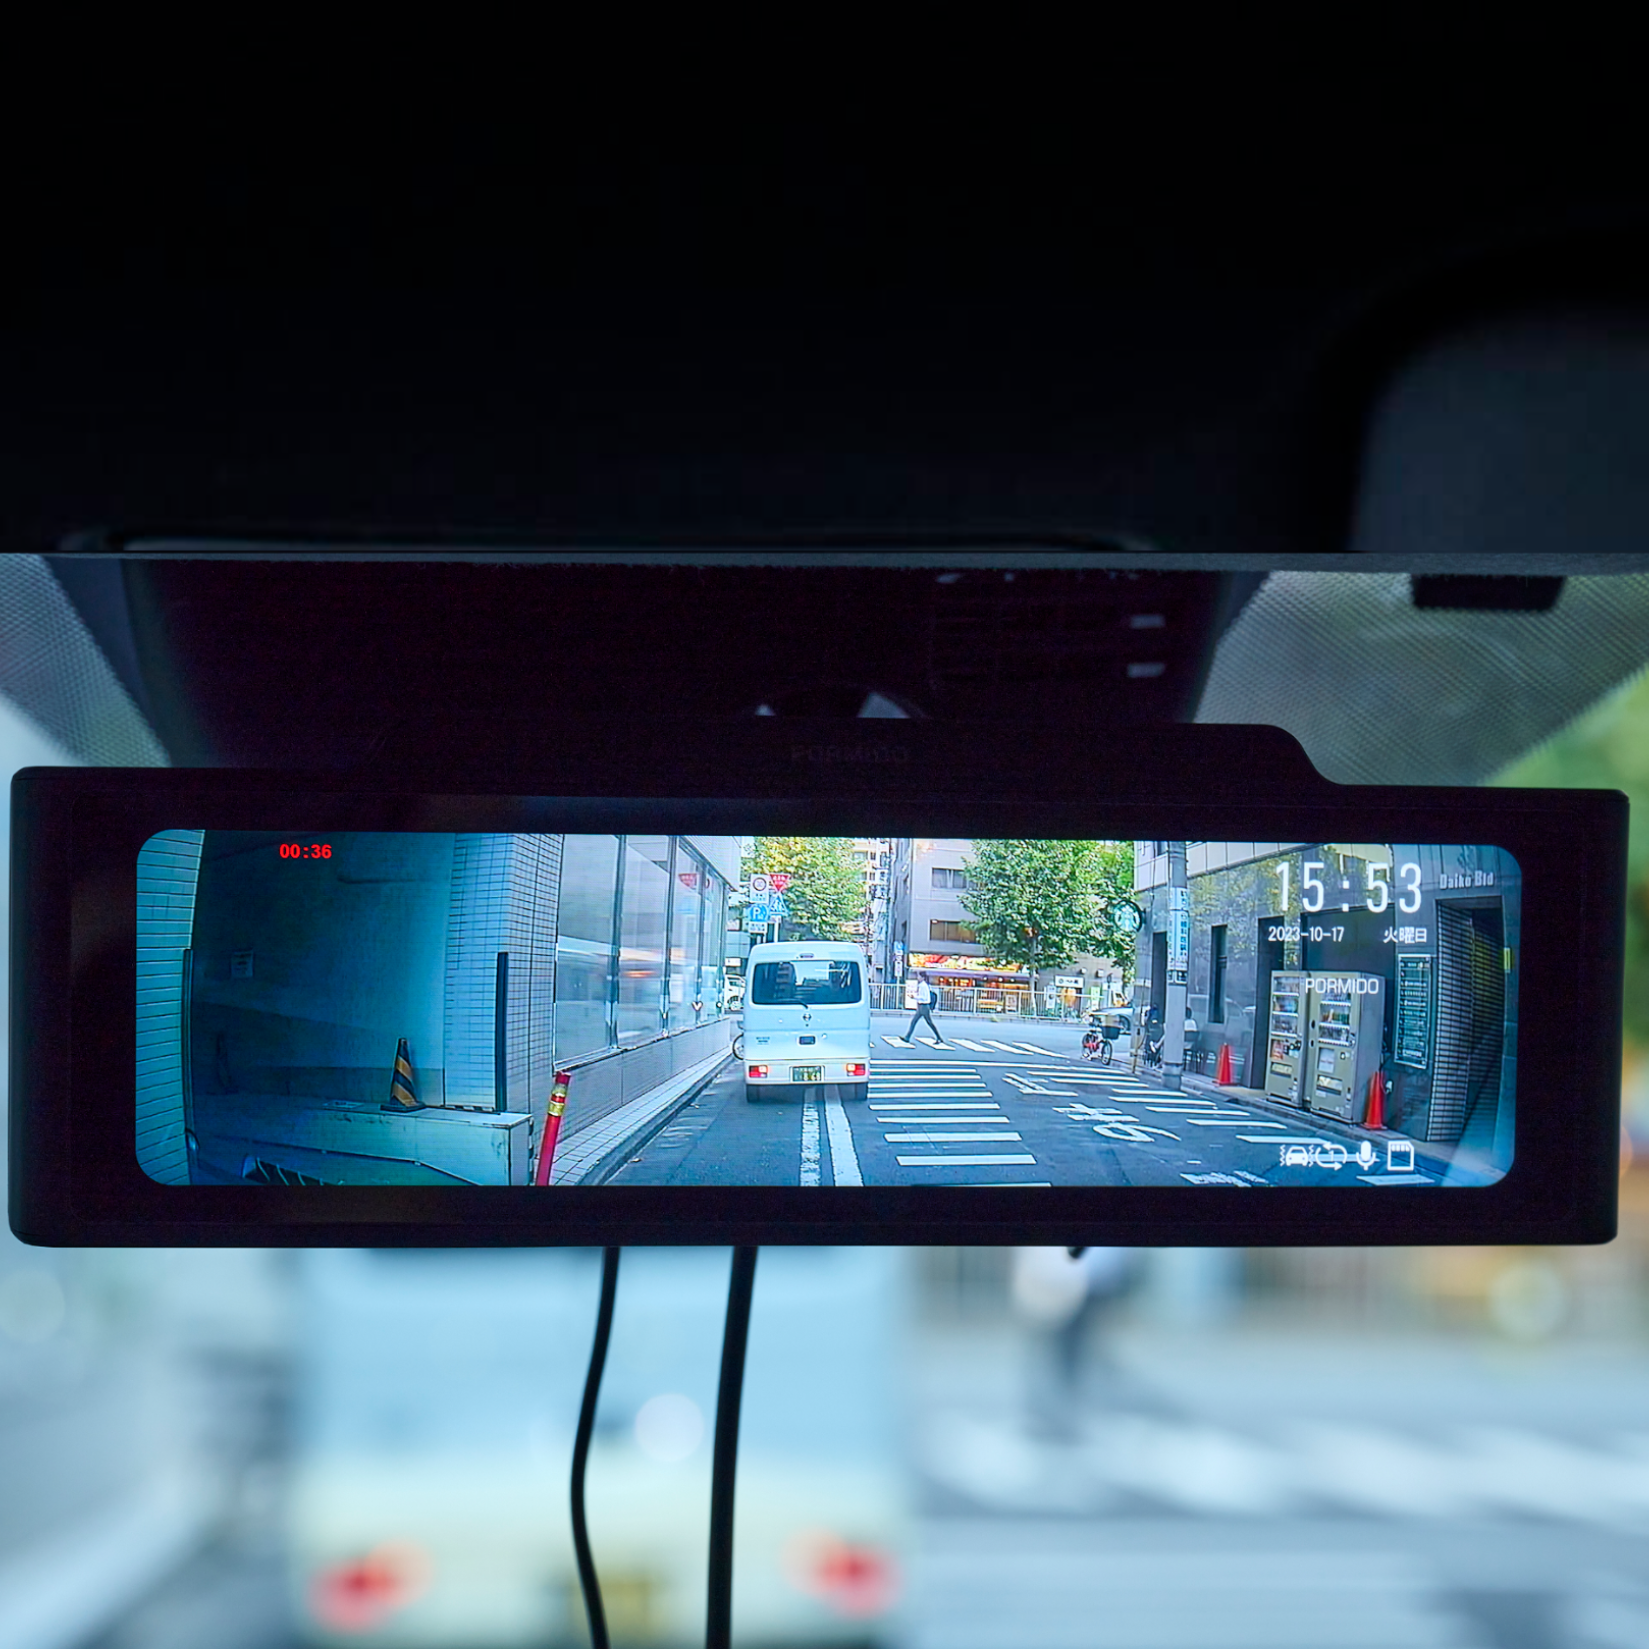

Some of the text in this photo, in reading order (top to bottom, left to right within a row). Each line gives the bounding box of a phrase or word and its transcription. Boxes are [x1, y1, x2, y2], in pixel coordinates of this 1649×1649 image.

[279, 843, 333, 859] 00:36
[1275, 861, 1422, 913] 15:53
[1440, 870, 1494, 889] Daiko Bld
[1267, 926, 1345, 943] 2023-10-17
[1382, 927, 1428, 944] 火曜日
